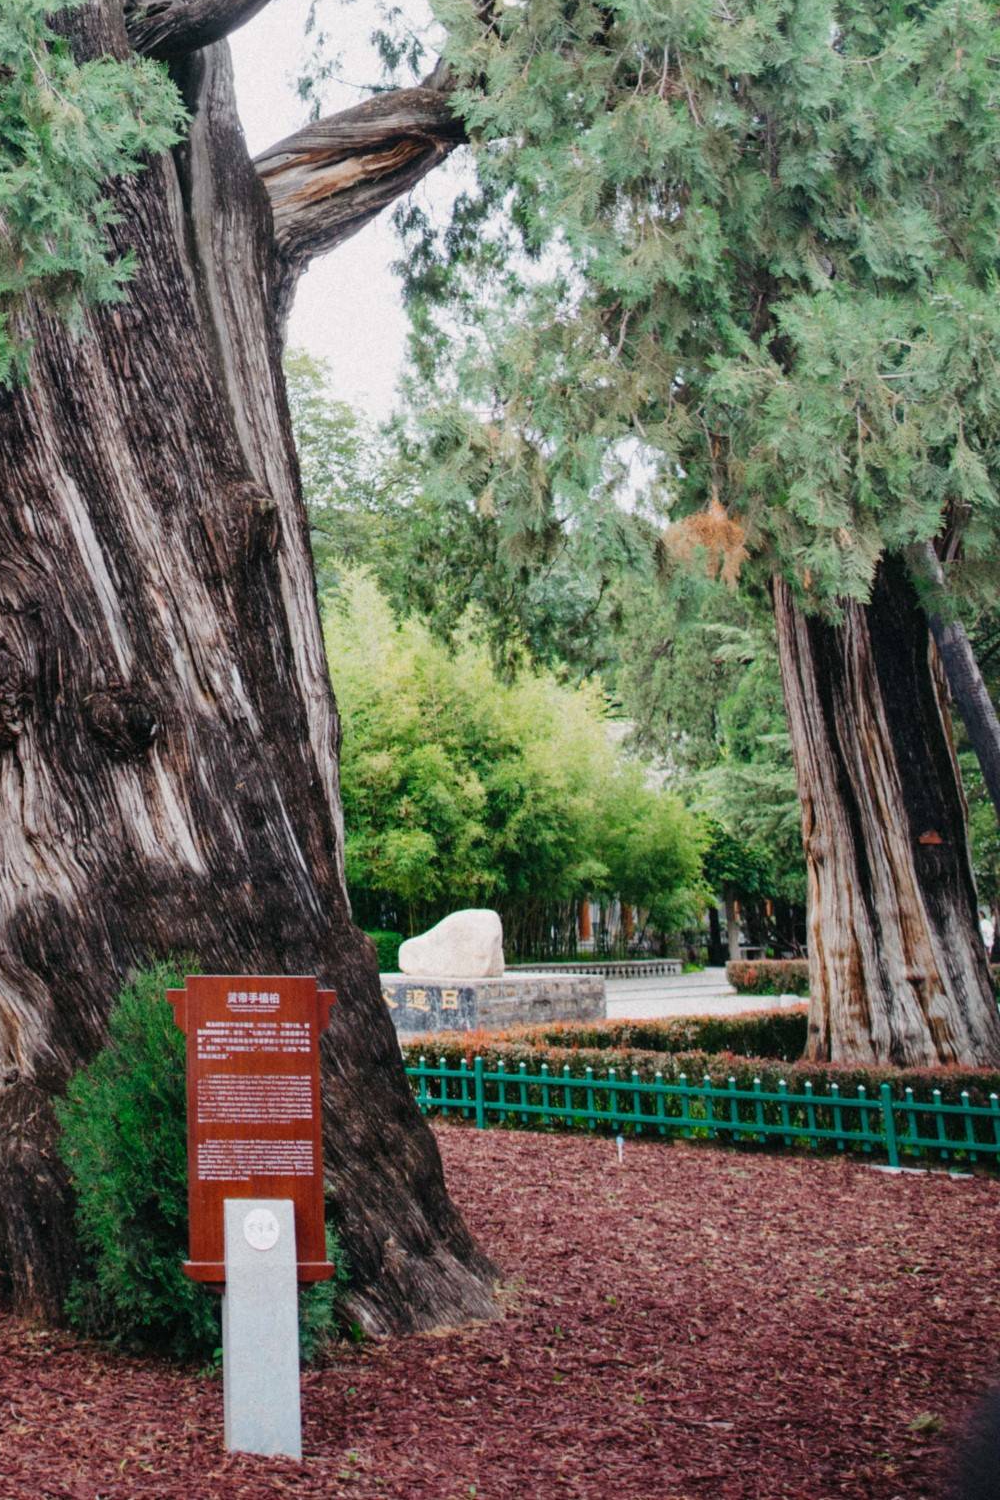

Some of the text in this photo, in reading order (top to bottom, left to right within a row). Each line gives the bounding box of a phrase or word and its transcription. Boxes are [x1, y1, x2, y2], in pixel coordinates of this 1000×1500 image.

[227, 991, 281, 1004] 黄帝手植柏
